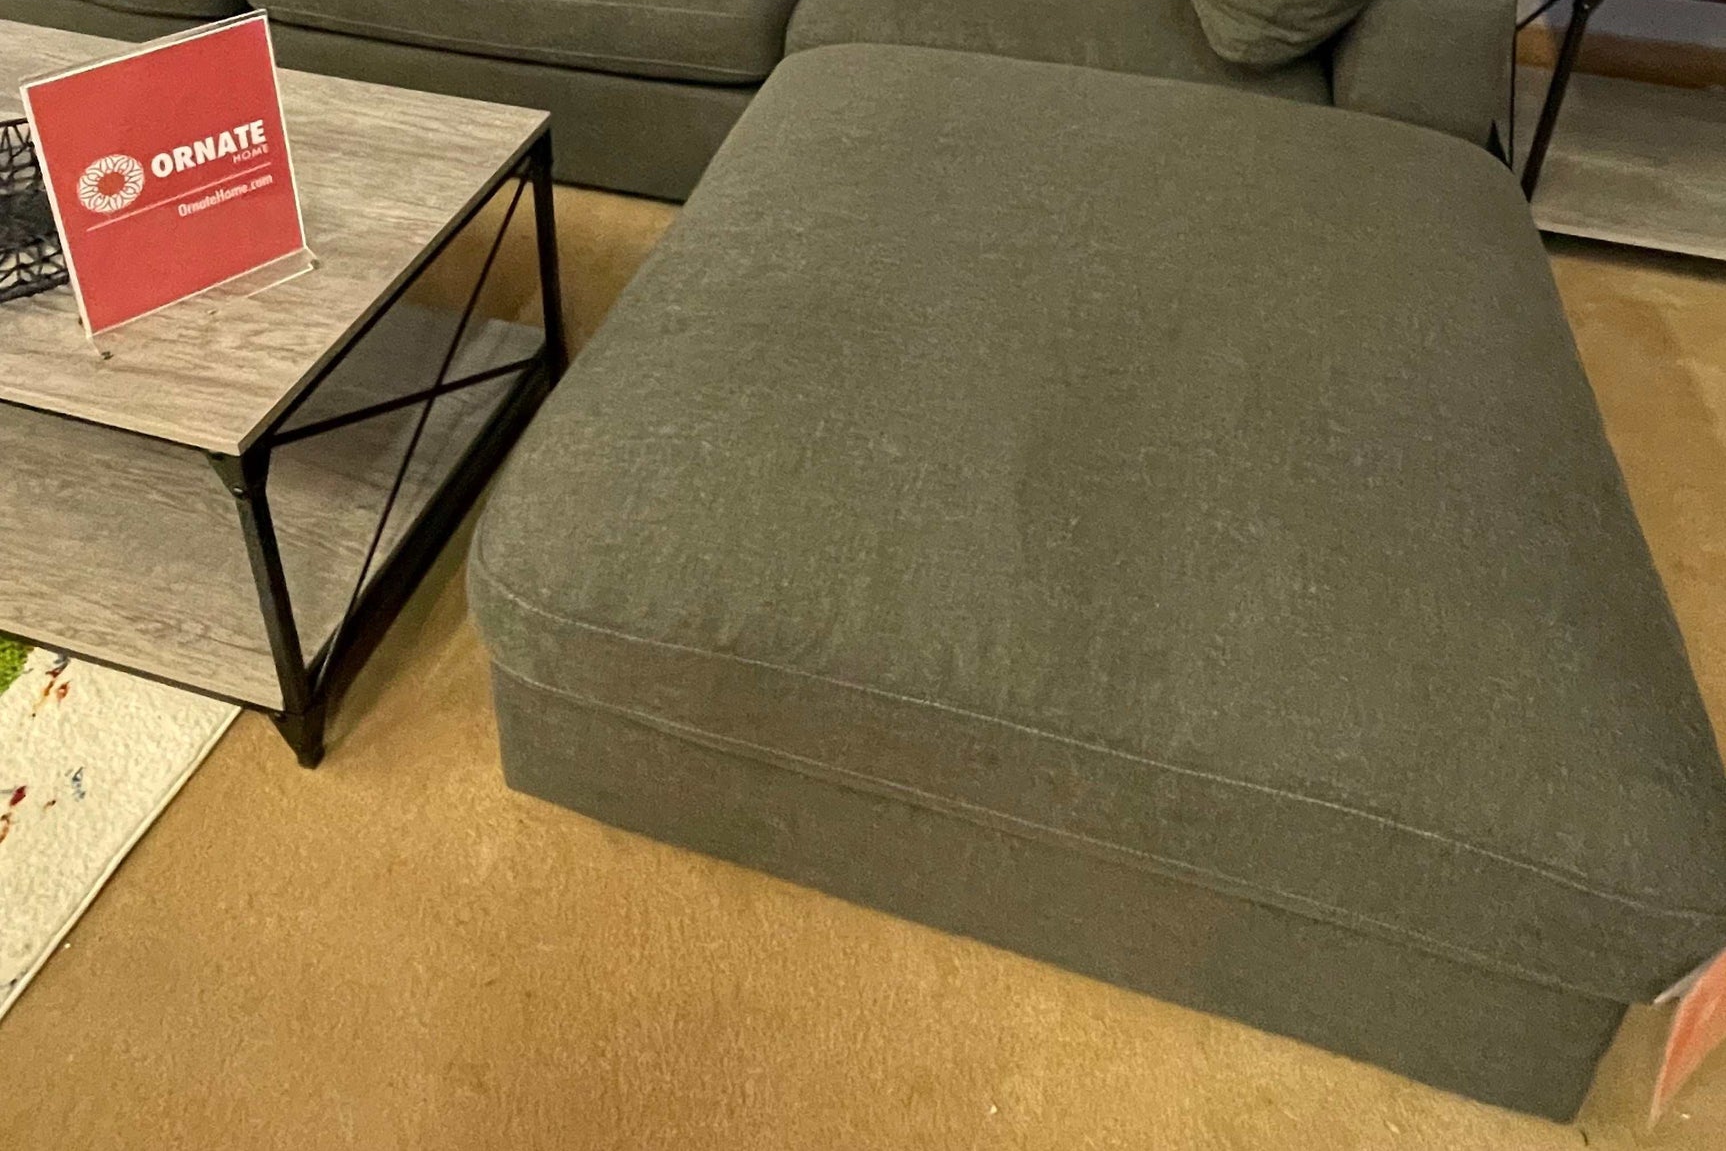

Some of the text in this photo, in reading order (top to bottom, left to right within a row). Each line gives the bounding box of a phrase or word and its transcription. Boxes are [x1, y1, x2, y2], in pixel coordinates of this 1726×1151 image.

[151, 120, 267, 178] ORNATE
[232, 144, 270, 164] HOME
[178, 174, 273, 217] OrnateHome.com
